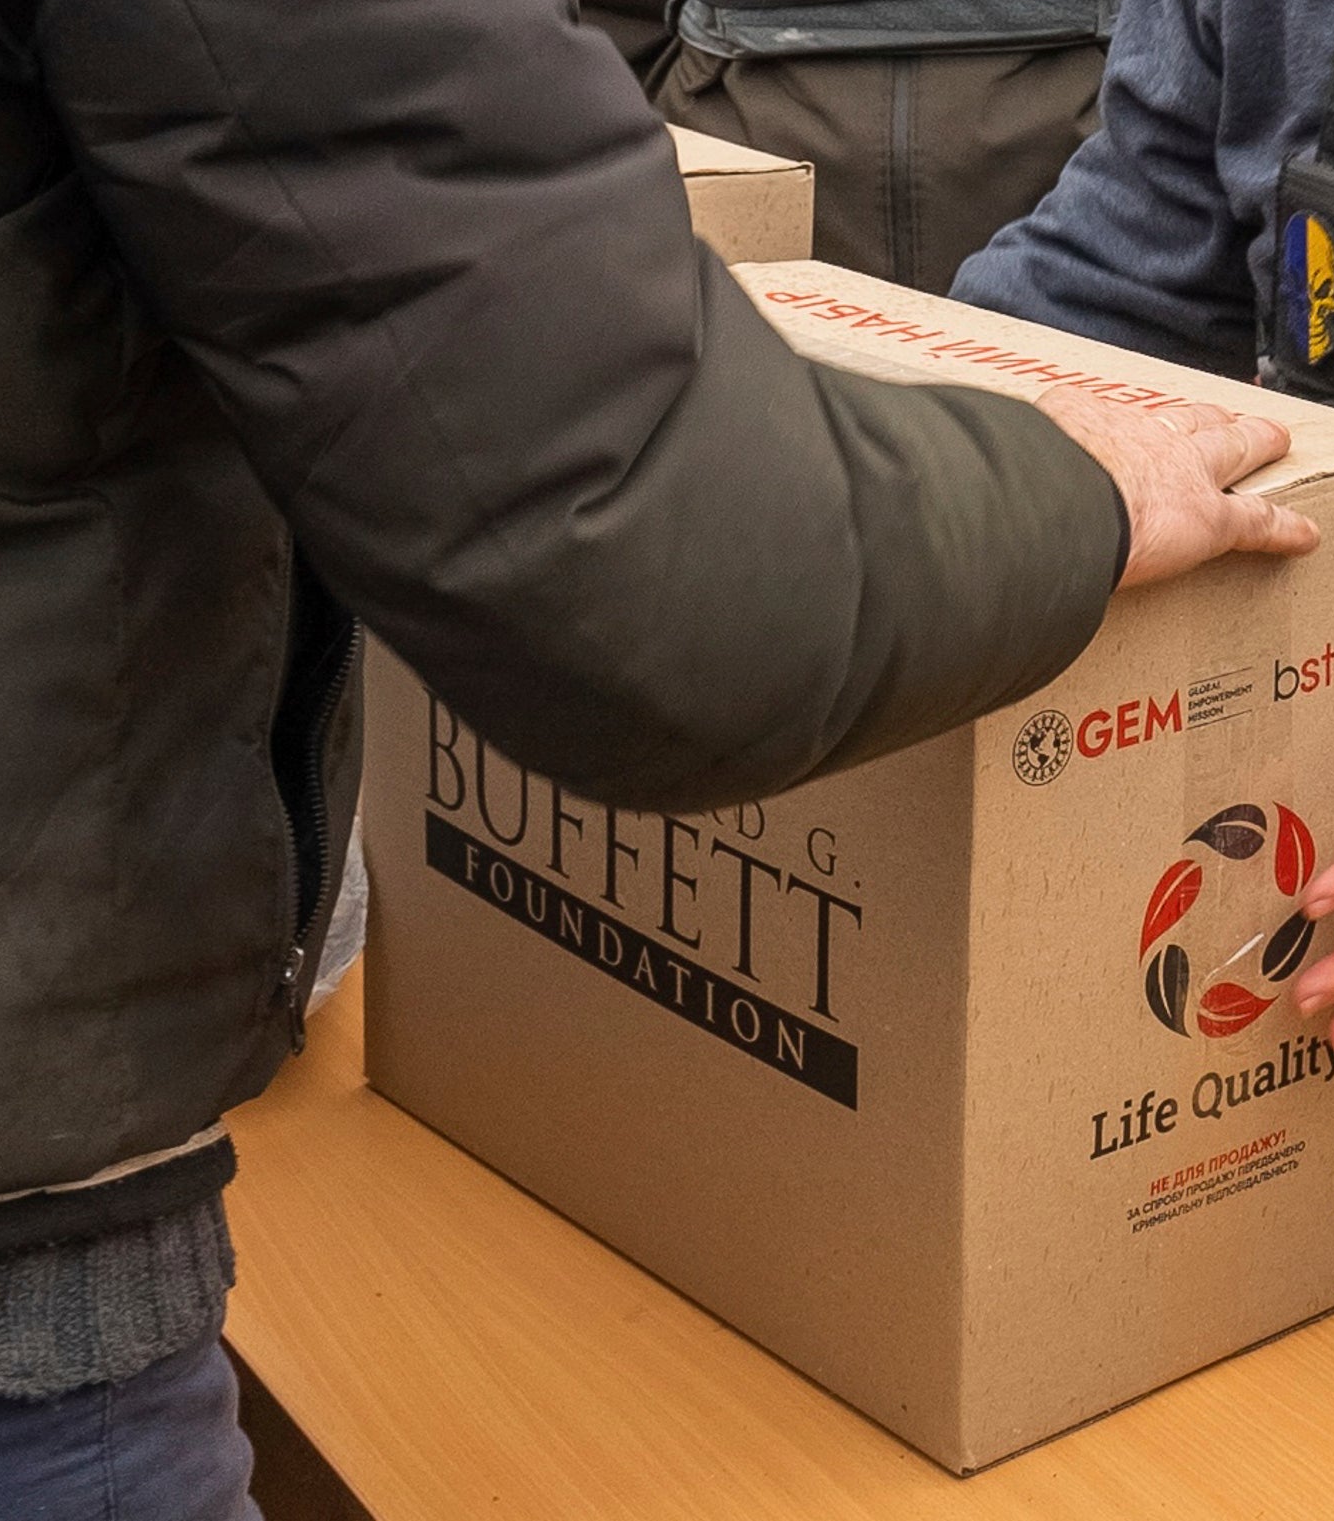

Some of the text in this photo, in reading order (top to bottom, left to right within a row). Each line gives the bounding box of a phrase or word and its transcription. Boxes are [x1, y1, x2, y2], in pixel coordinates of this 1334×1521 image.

[765, 292, 945, 342] НАБІР
[1077, 688, 1183, 759] GEM
[466, 842, 806, 1071] FOUNDATION
[1090, 1090, 1179, 1161] Life
[1127, 1140, 1306, 1221] ЗА СПРОБУ ПРОДАЖУ ПЕРЕДБАЧЕНО
[1132, 1160, 1299, 1233] КРИМІНАЛЬНУ ВІДПОВІДАЛЬНІСТЬ
[1150, 1129, 1287, 1196] НЕ ДЛЯ ПРОДАЖУ!
